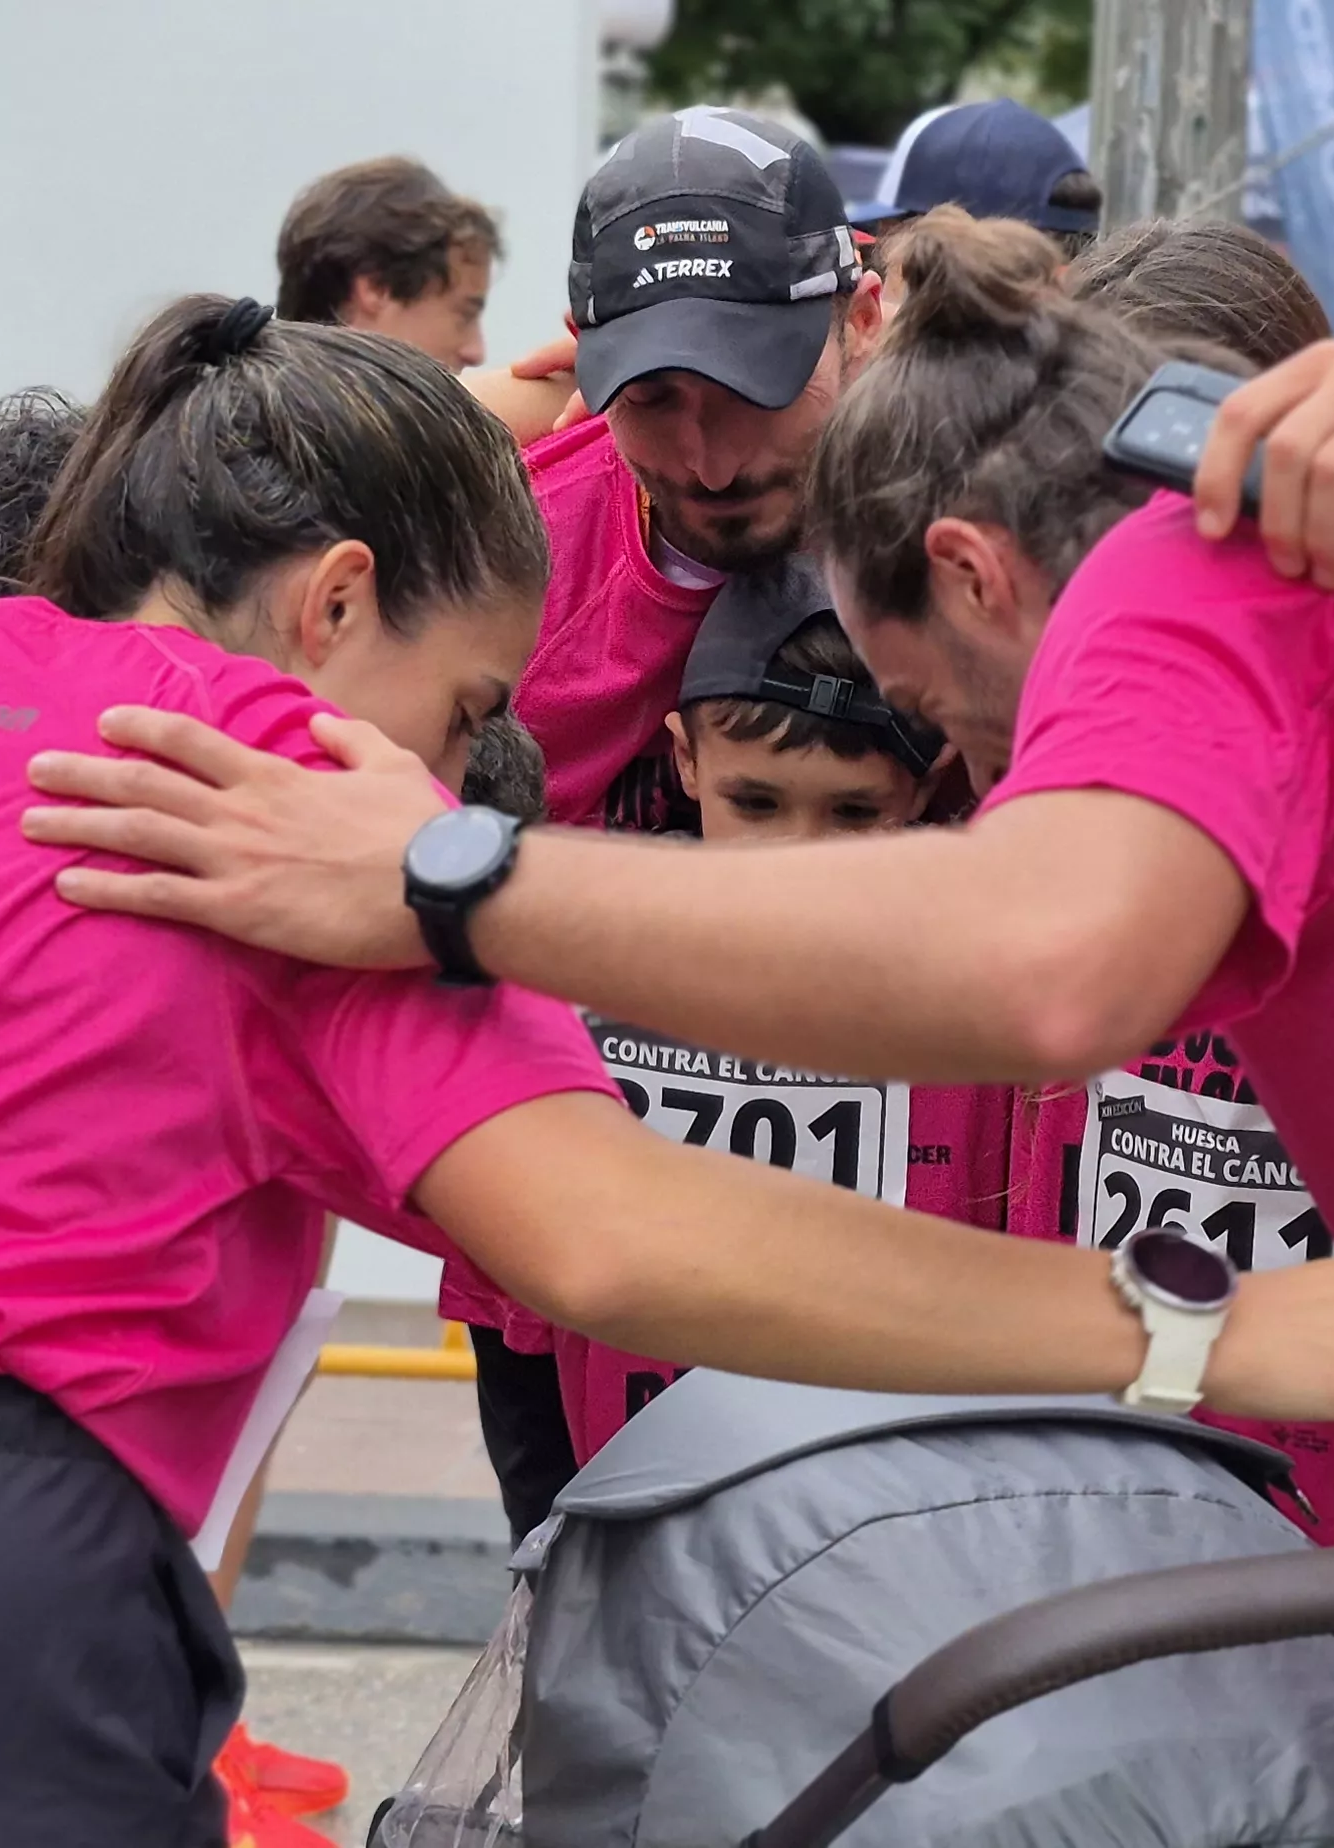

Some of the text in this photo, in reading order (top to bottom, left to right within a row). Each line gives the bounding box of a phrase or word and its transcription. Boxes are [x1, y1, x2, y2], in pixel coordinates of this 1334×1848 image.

[655, 220, 728, 234] TRANSVULCANIA
[654, 259, 733, 281] TERREX
[602, 1036, 712, 1075] CONTRA
[717, 1055, 748, 1081] EL
[1110, 1128, 1185, 1173] CONTRA
[1191, 1151, 1216, 1179] EL
[1171, 1122, 1241, 1155] HUESCA
